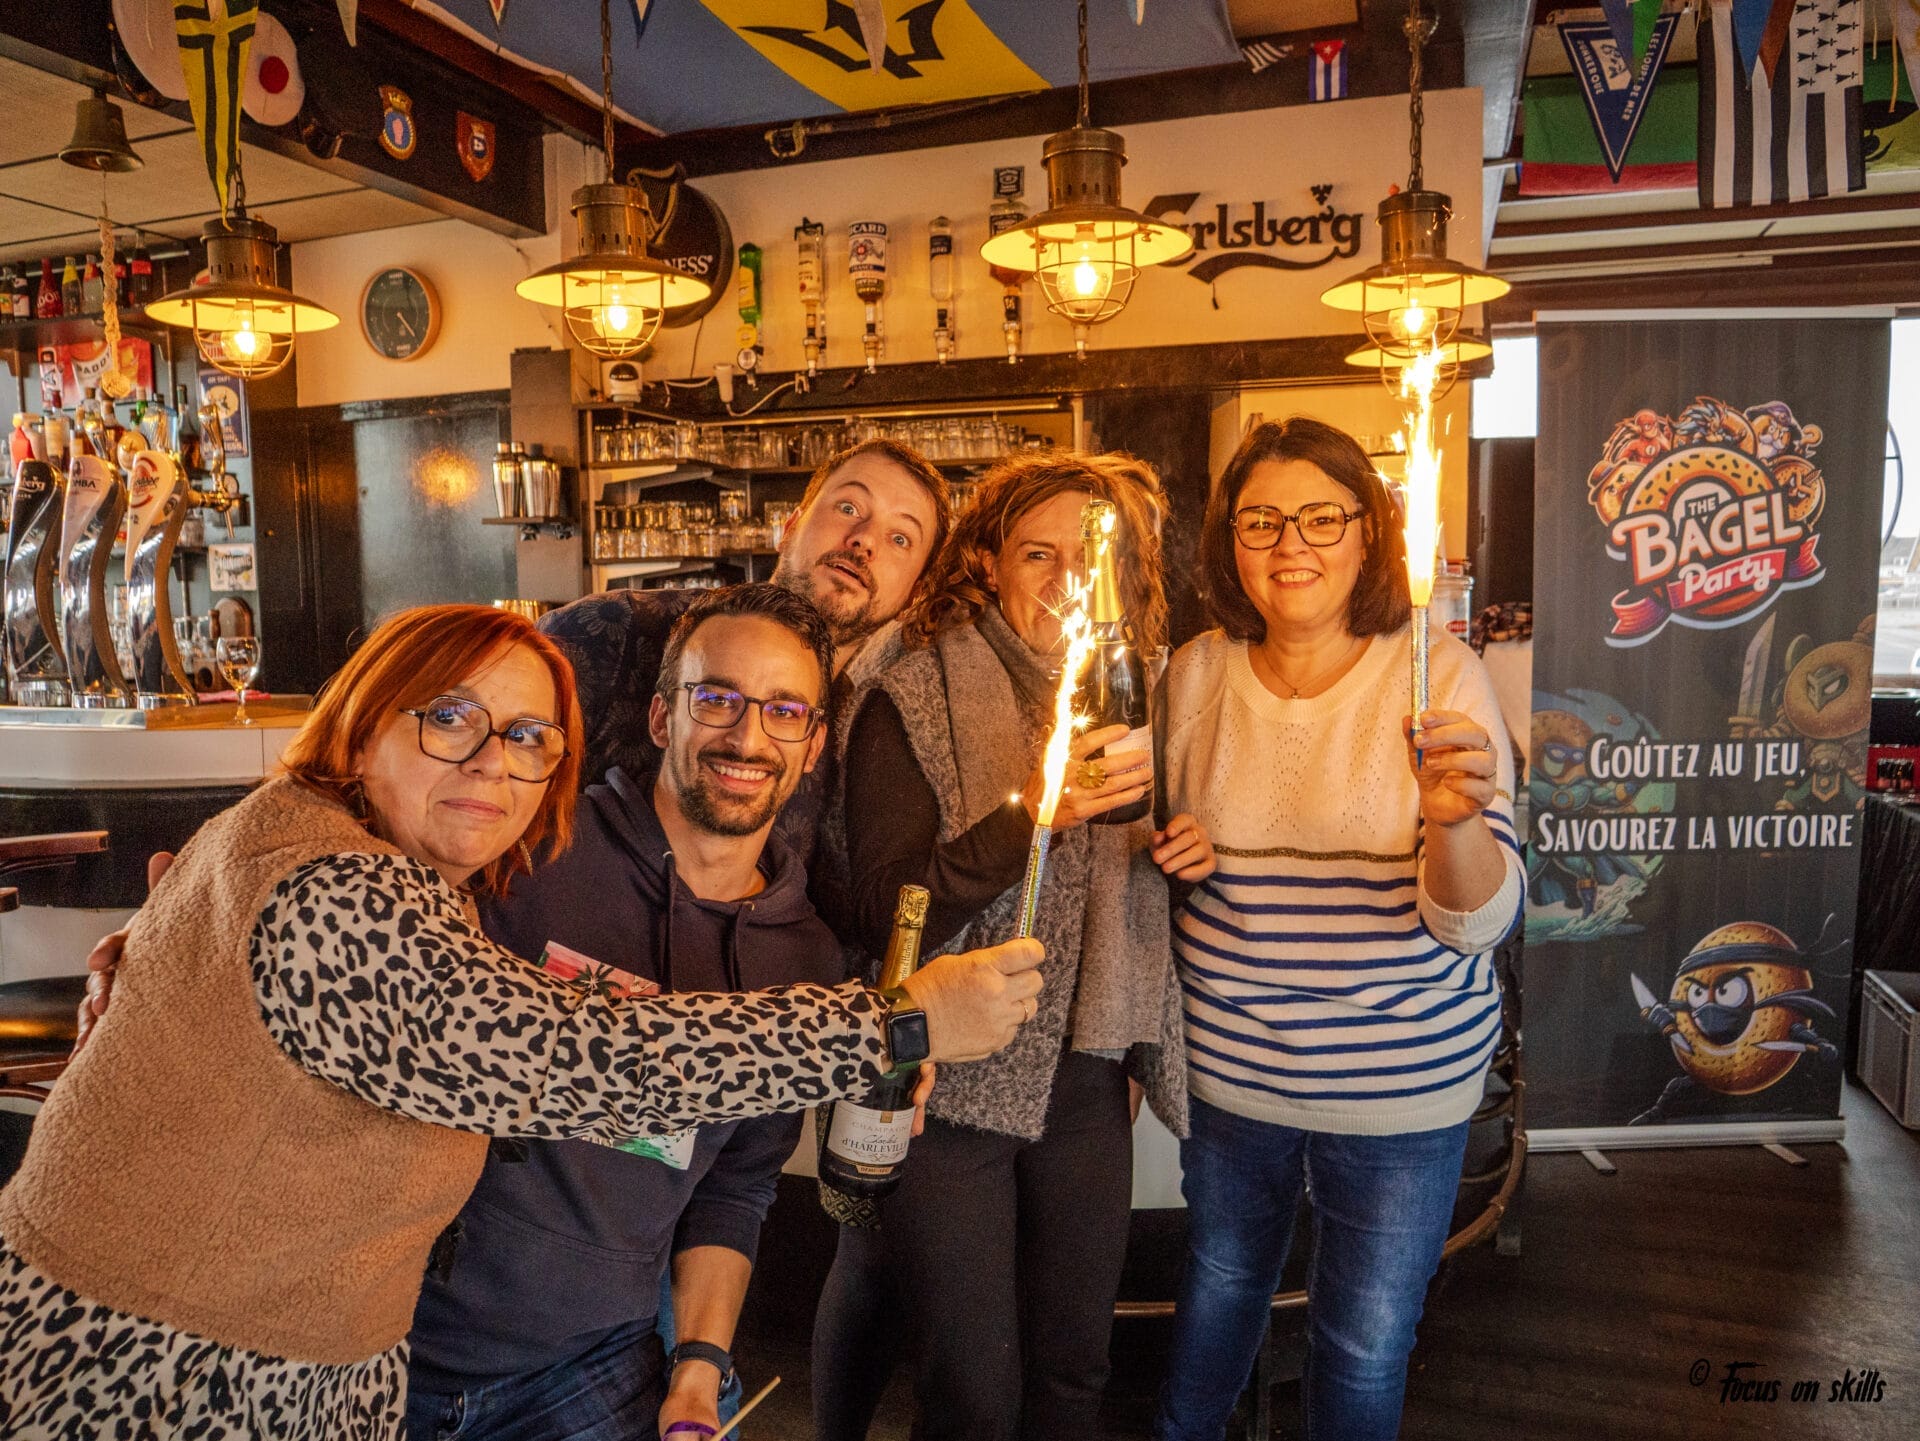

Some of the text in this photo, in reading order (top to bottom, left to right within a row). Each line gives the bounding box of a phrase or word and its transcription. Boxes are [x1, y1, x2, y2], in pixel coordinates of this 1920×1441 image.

[1649, 32, 1662, 50] LES
[1629, 84, 1641, 97] DE
[1688, 496, 1717, 516] THE
[1612, 491, 1803, 585] BAGEL
[1678, 557, 1776, 603] Party
[1590, 737, 1806, 782] GOÛTEZ AU JEU,
[1538, 813, 1855, 852] SAVOUREZ LA VICTOIRE
